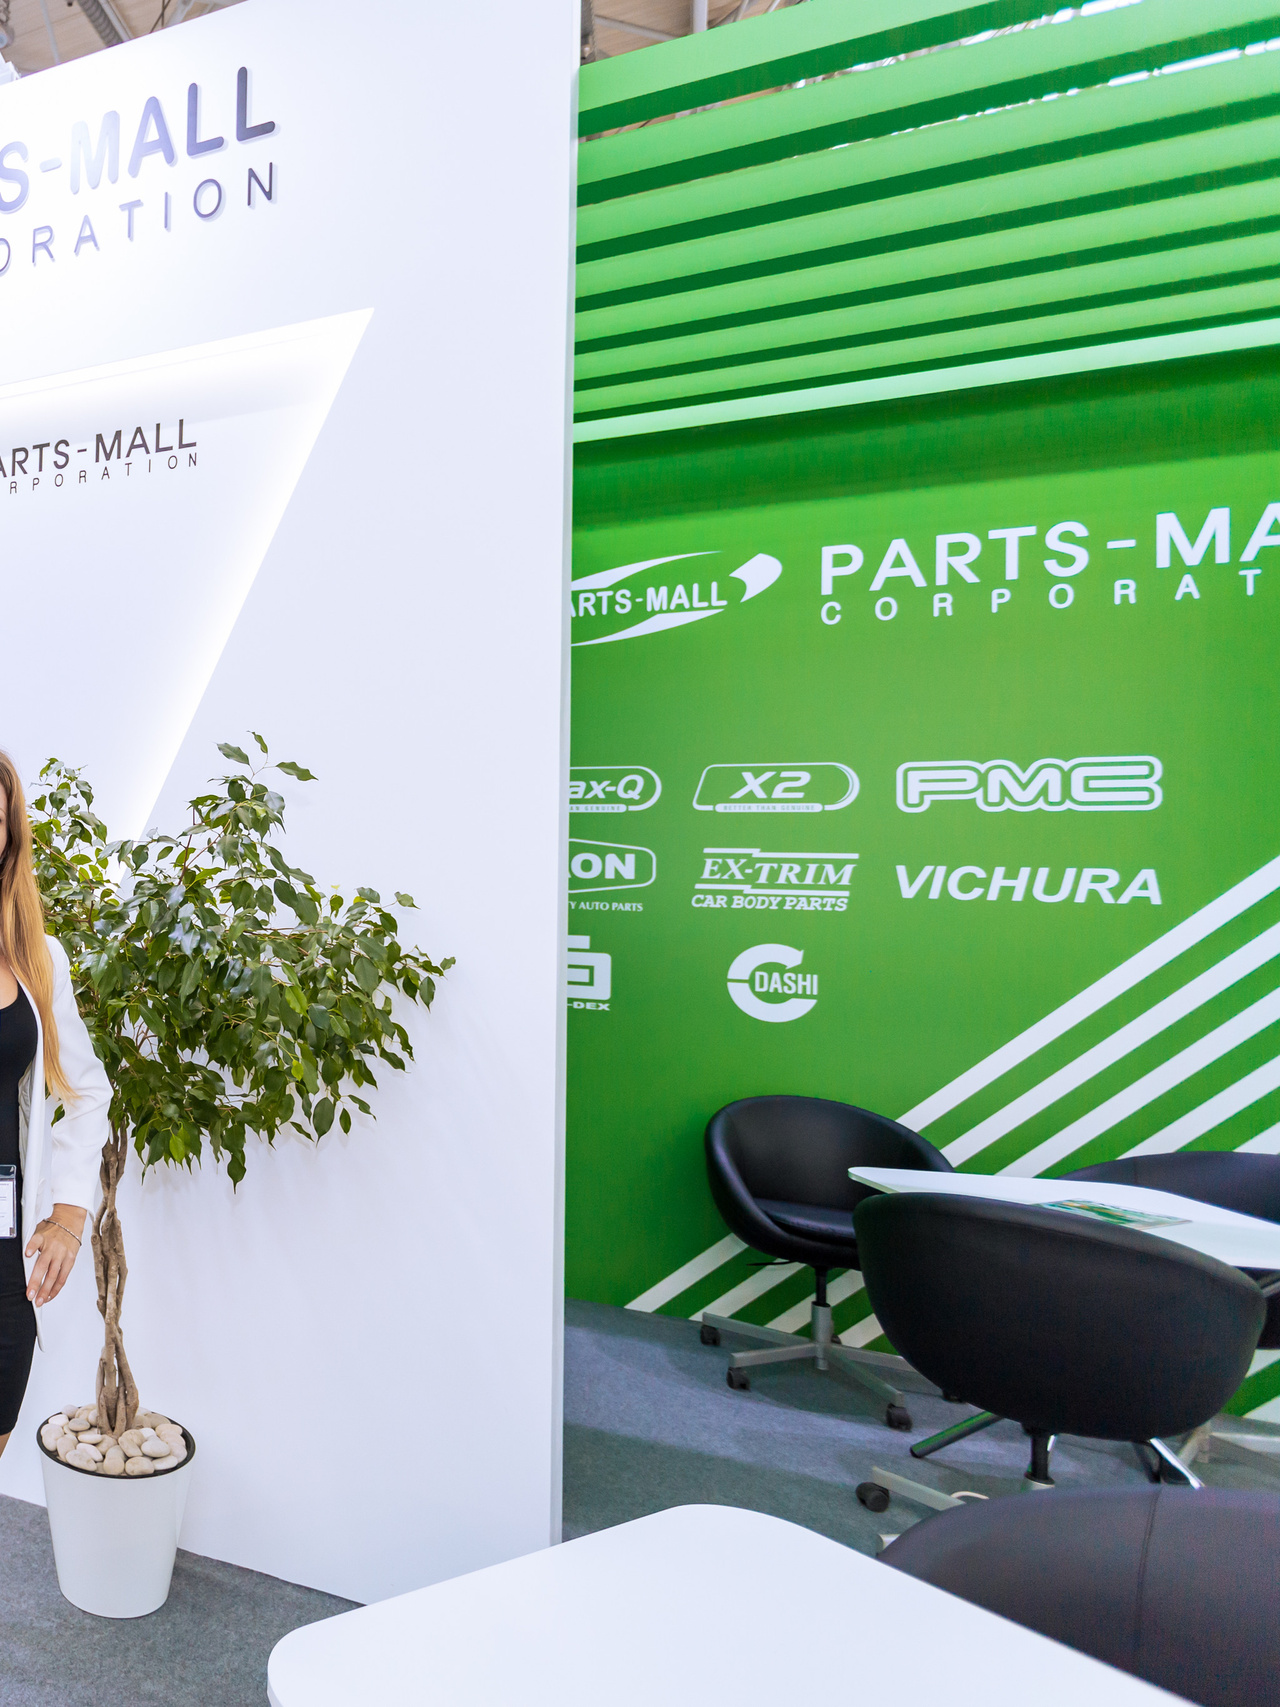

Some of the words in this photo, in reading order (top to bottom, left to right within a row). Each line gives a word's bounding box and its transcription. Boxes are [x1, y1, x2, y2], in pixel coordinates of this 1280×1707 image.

[821, 568, 1262, 625] CORPORAT
[729, 771, 811, 799] X2
[569, 853, 636, 880] ON
[700, 858, 858, 886] EX-TRIM
[895, 865, 1163, 905] VICHURA
[579, 901, 610, 911] AUTO
[612, 902, 644, 912] PARTS
[691, 894, 728, 908] CAR
[731, 896, 782, 910] BODY
[783, 897, 848, 912] PARTS
[754, 971, 819, 996] DASHI
